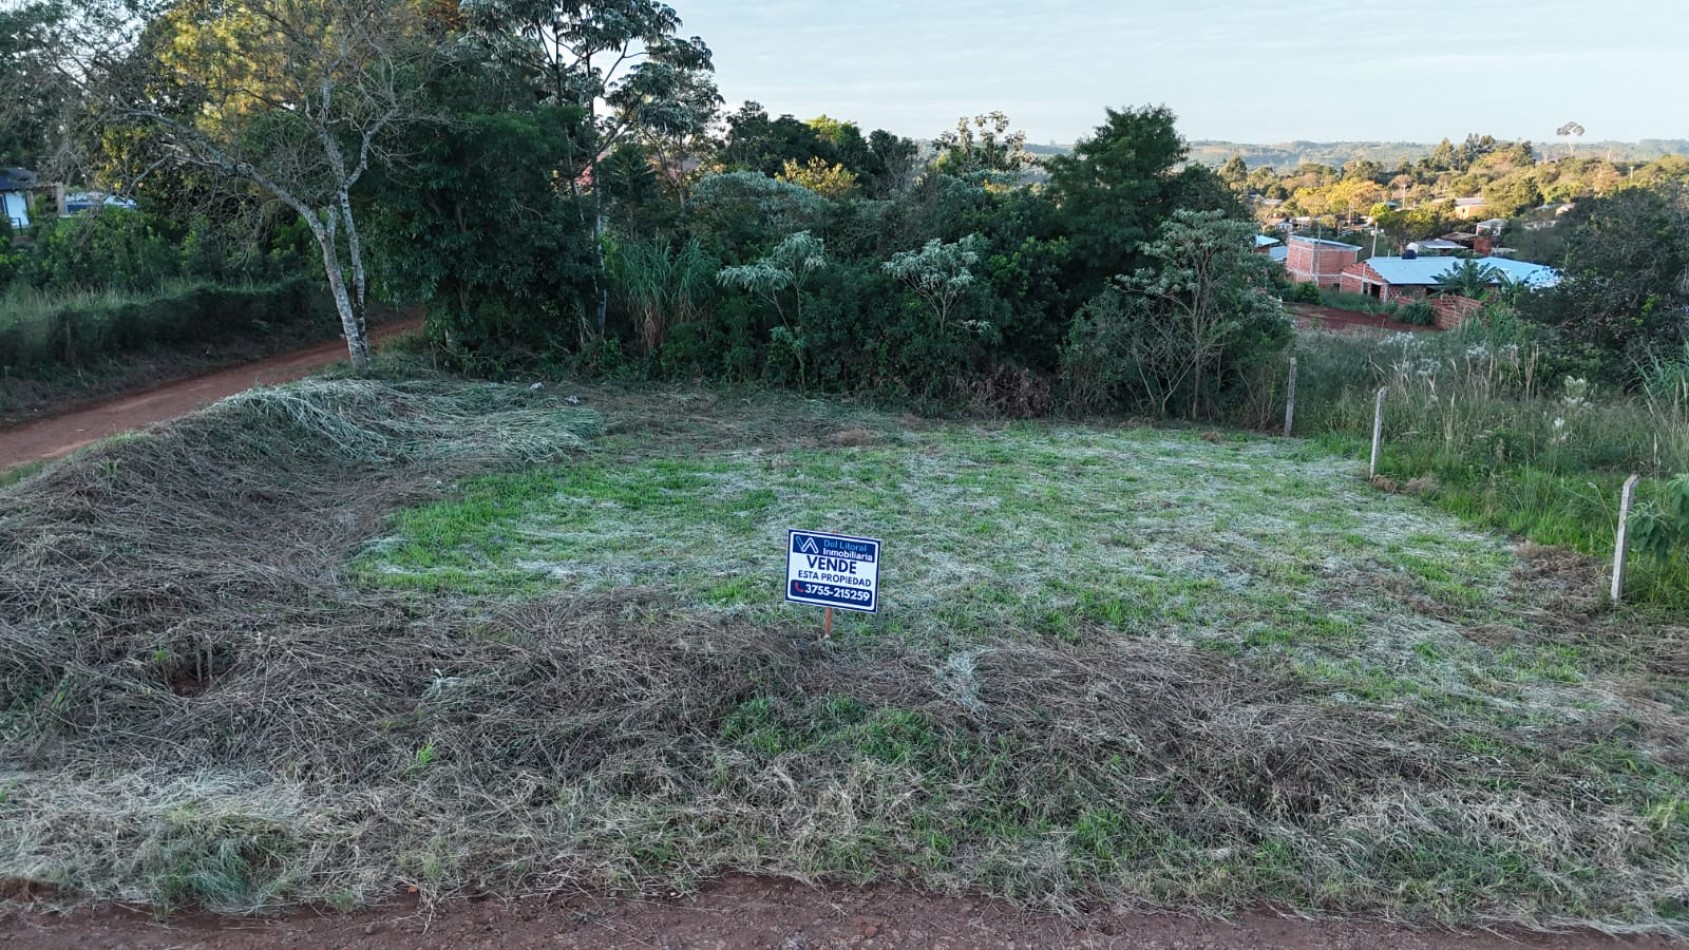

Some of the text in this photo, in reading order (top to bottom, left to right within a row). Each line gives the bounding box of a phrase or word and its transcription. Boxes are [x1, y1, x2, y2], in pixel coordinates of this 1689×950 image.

[824, 540, 867, 552] Del Litoral
[822, 548, 873, 562] Inmobiliaria
[806, 554, 857, 574] VENDE
[798, 570, 872, 586] ESTA PROPIEDAD
[804, 584, 870, 602] 3755-215259
